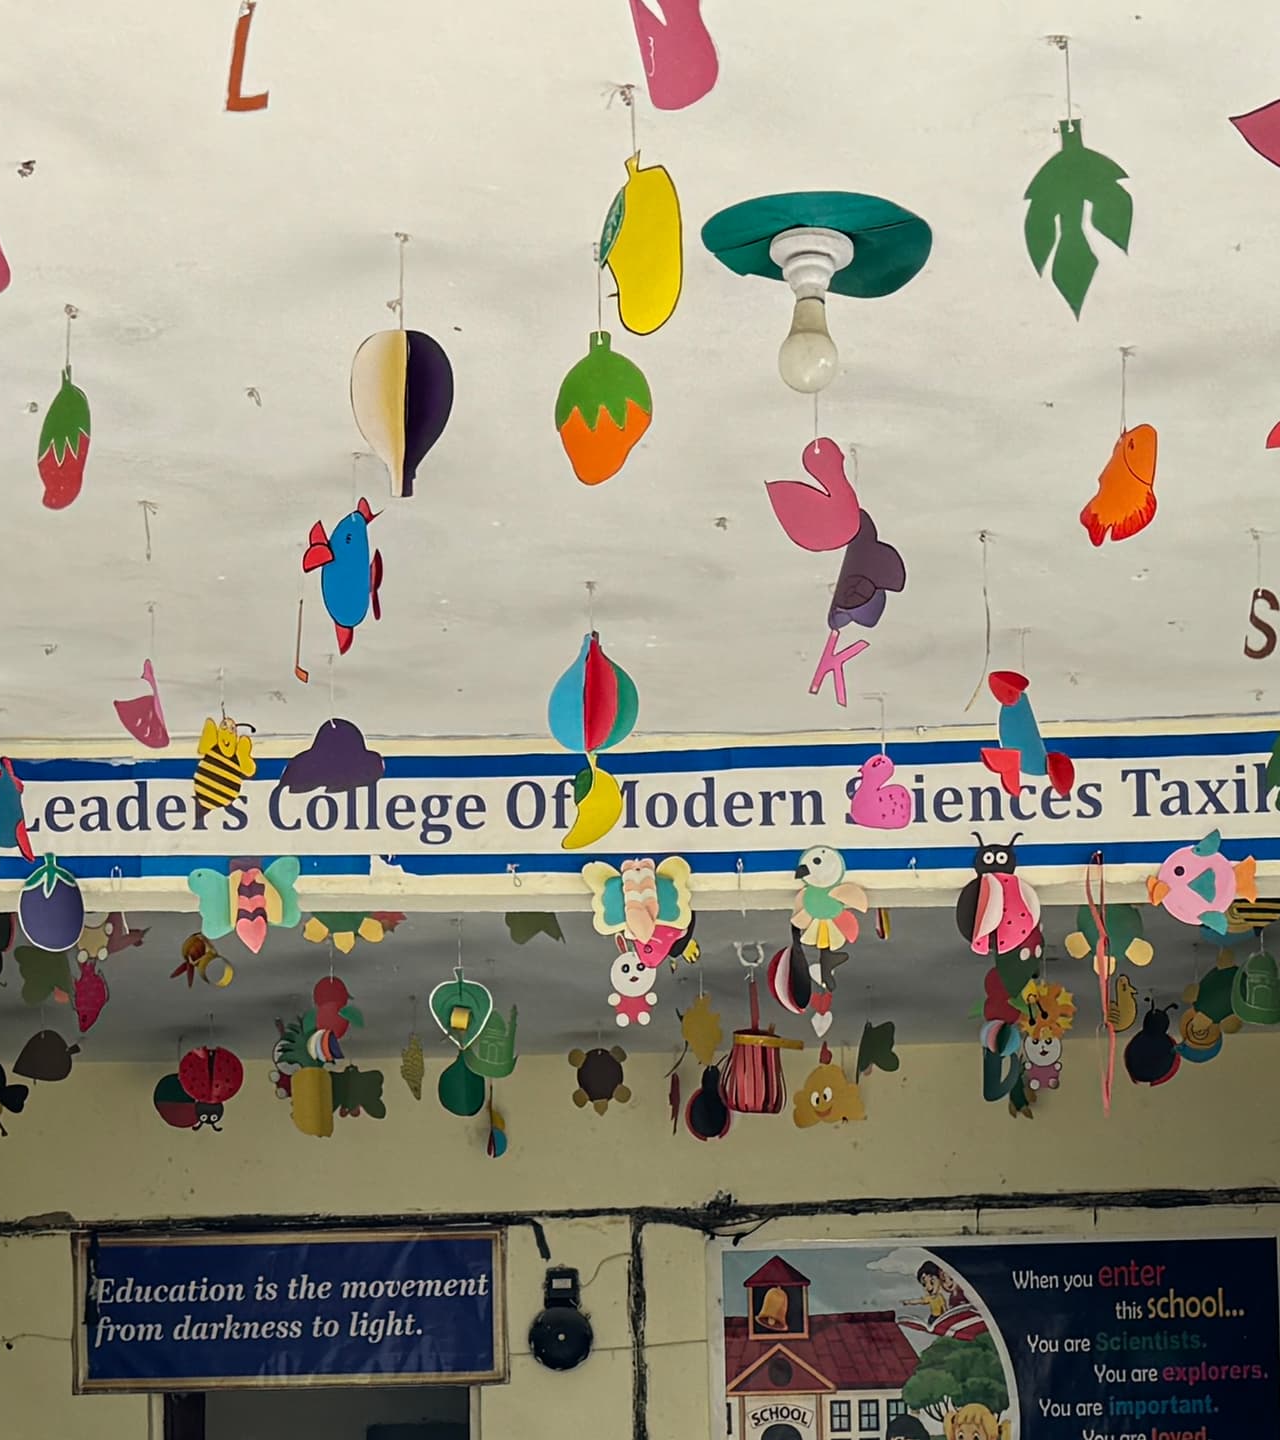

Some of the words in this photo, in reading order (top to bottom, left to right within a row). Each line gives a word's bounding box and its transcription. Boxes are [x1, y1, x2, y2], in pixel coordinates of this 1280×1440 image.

[226, 2, 269, 112] L
[1244, 587, 1280, 659] S
[808, 628, 870, 707] K
[506, 778, 575, 829] Of
[845, 774, 1102, 825] iences
[97, 1277, 245, 1303] Education
[255, 1276, 278, 1300] is
[288, 1274, 332, 1300] the
[341, 1274, 488, 1298] movement
[1012, 1270, 1059, 1290] When
[1063, 1273, 1093, 1292] you
[1098, 1259, 1166, 1287] enter
[1115, 1301, 1143, 1320] this
[1147, 1288, 1245, 1319] school...
[95, 1315, 164, 1348] from
[173, 1314, 303, 1341] darkness
[312, 1315, 339, 1337] to
[349, 1311, 423, 1343] light.
[1027, 1334, 1059, 1353] You
[1064, 1338, 1091, 1352] are
[1095, 1330, 1208, 1351] Scientists.
[1094, 1363, 1126, 1383] You
[1131, 1367, 1158, 1382] are
[1162, 1361, 1269, 1386] explorers.
[751, 1406, 808, 1427] SCHOOL
[1039, 1398, 1070, 1417] You
[1076, 1401, 1103, 1416] are
[1109, 1395, 1219, 1419] important.
